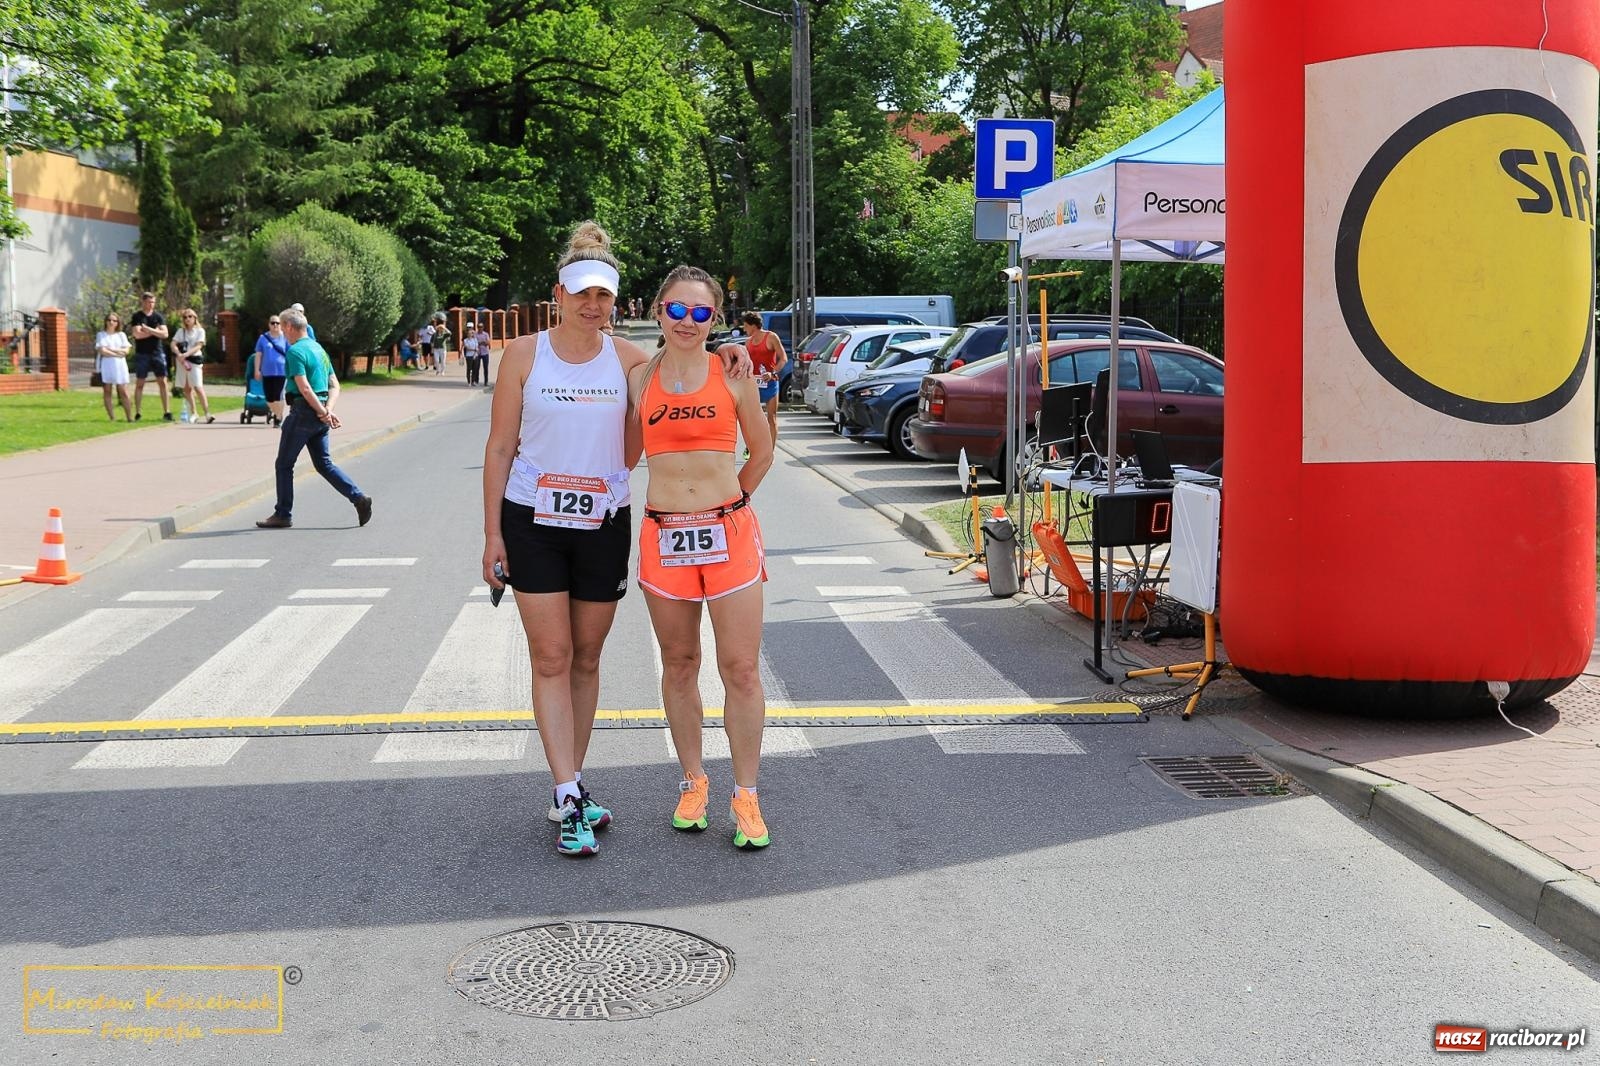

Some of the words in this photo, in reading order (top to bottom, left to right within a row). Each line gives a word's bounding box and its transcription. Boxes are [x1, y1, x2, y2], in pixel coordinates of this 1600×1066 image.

[994, 129, 1038, 190] P
[571, 388, 619, 396] YOURSELF
[552, 491, 594, 516] 129
[671, 528, 713, 552] 215
